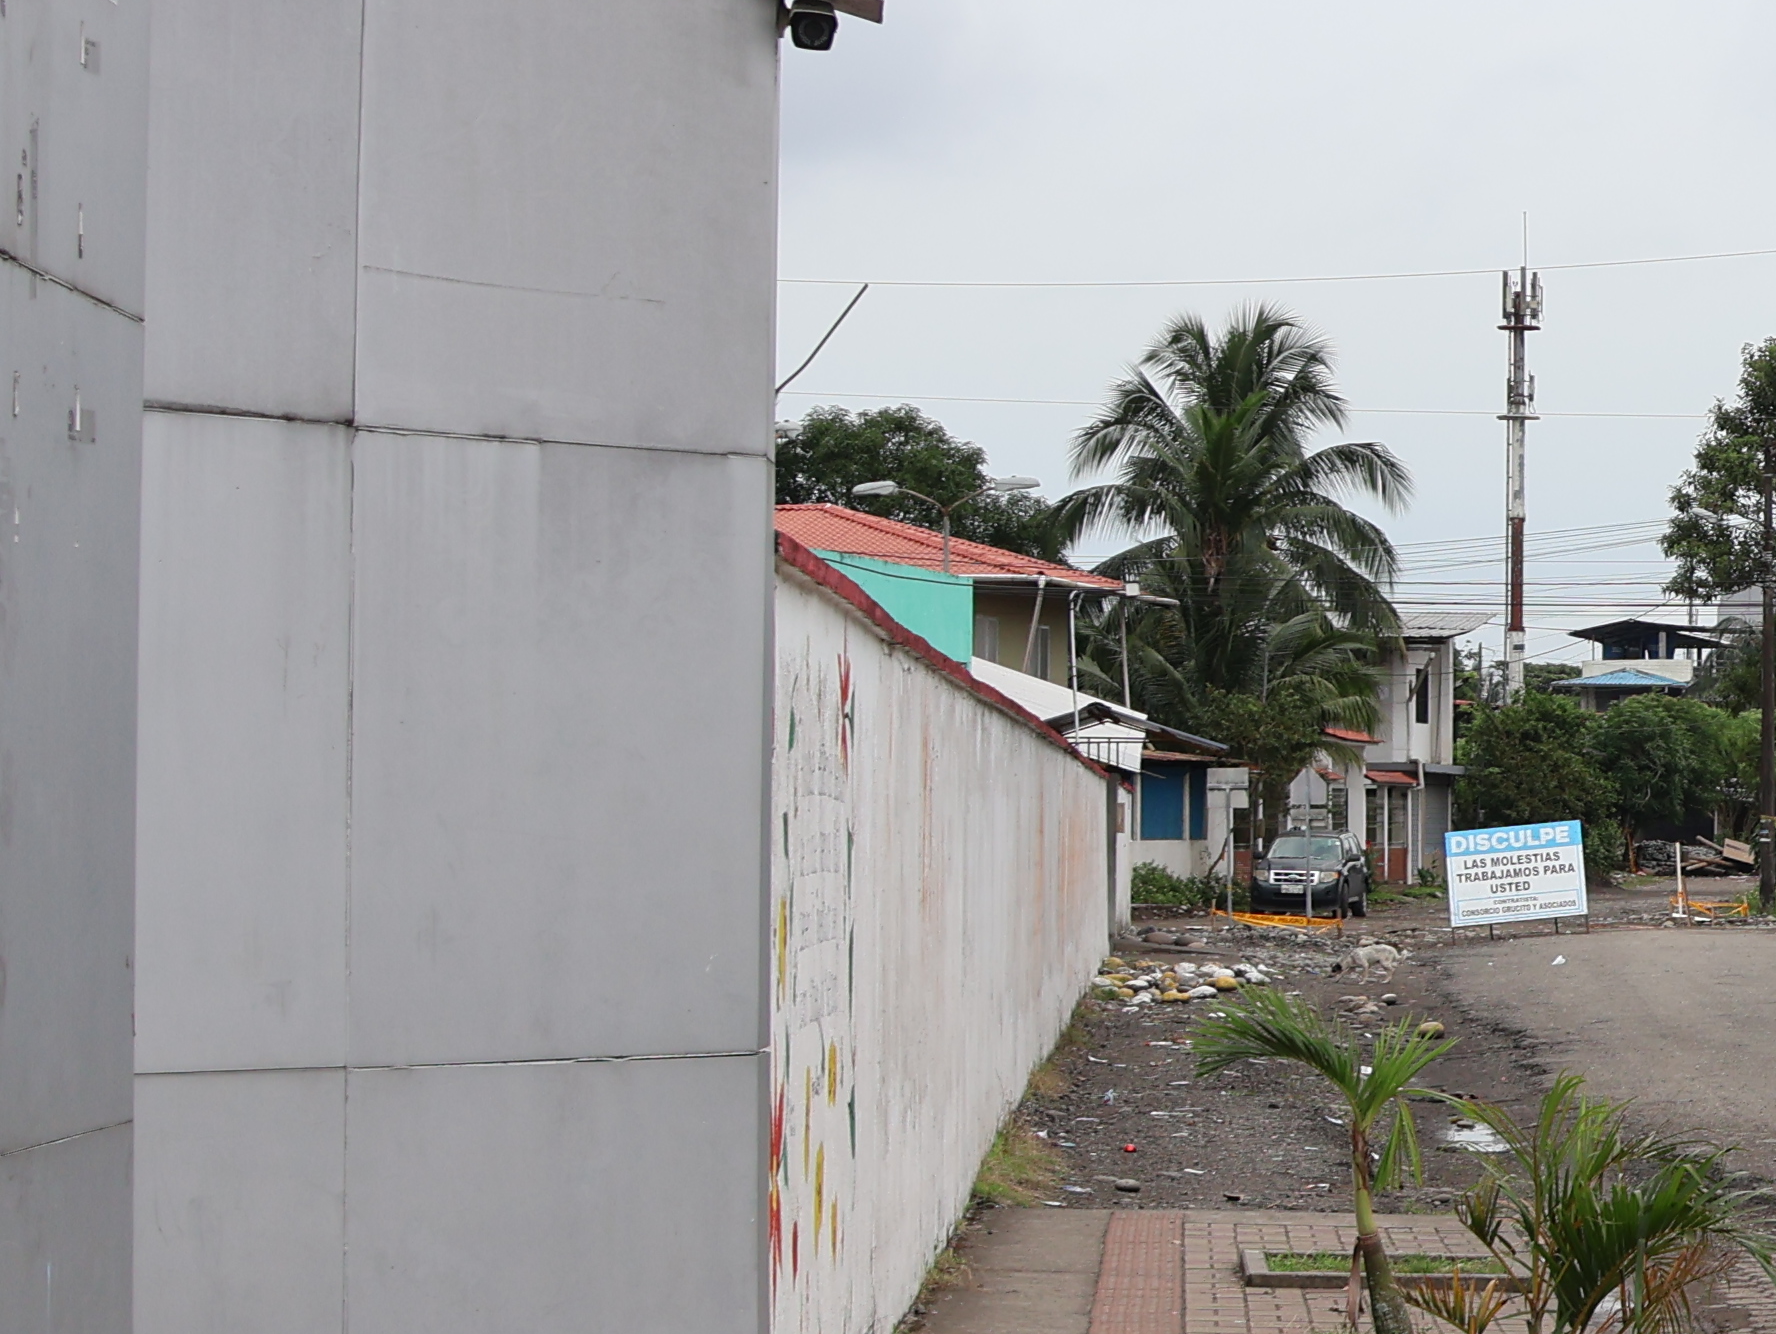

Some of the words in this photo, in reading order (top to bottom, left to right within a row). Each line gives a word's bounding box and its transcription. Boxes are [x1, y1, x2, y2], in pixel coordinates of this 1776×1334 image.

[1451, 826, 1570, 853] DISCULPE
[1464, 858, 1487, 870] LAS
[1491, 851, 1560, 867] MOLESTIAS
[1457, 866, 1540, 883] TRABAJAMOS
[1543, 863, 1575, 875] PARA
[1490, 881, 1531, 894] USTED
